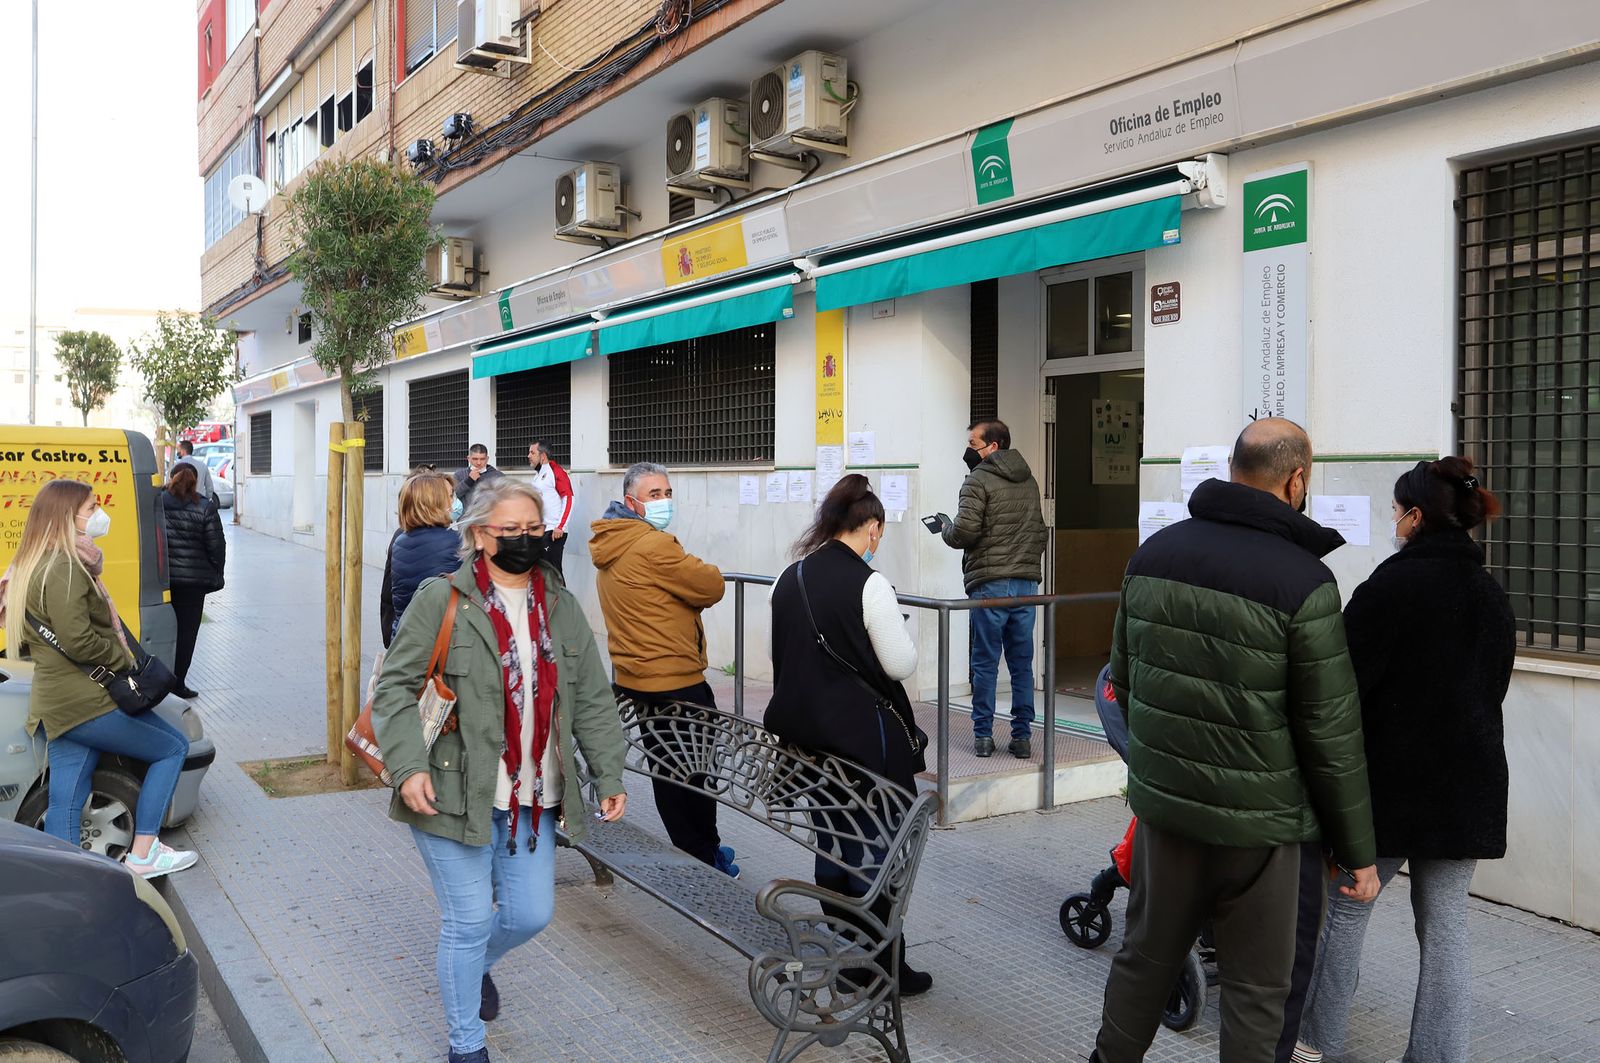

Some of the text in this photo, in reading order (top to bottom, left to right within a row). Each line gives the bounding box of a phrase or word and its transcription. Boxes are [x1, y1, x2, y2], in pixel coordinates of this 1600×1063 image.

[1103, 112, 1224, 154] Servicio Andaluz de Empleo
[1110, 92, 1222, 136] Oficina de Empleo
[1253, 226, 1266, 235] JUNTA
[1267, 224, 1273, 232] DE
[1261, 265, 1273, 307] Empleo
[1262, 310, 1271, 324] de
[1260, 327, 1271, 372] Andaluz
[1276, 263, 1286, 417] MPLEO, EMPRESA Y COMERCIO
[1260, 374, 1271, 416] Servicio
[31, 448, 92, 465] Castro,
[98, 450, 127, 463] S.L.
[39, 624, 56, 641] LOLA
